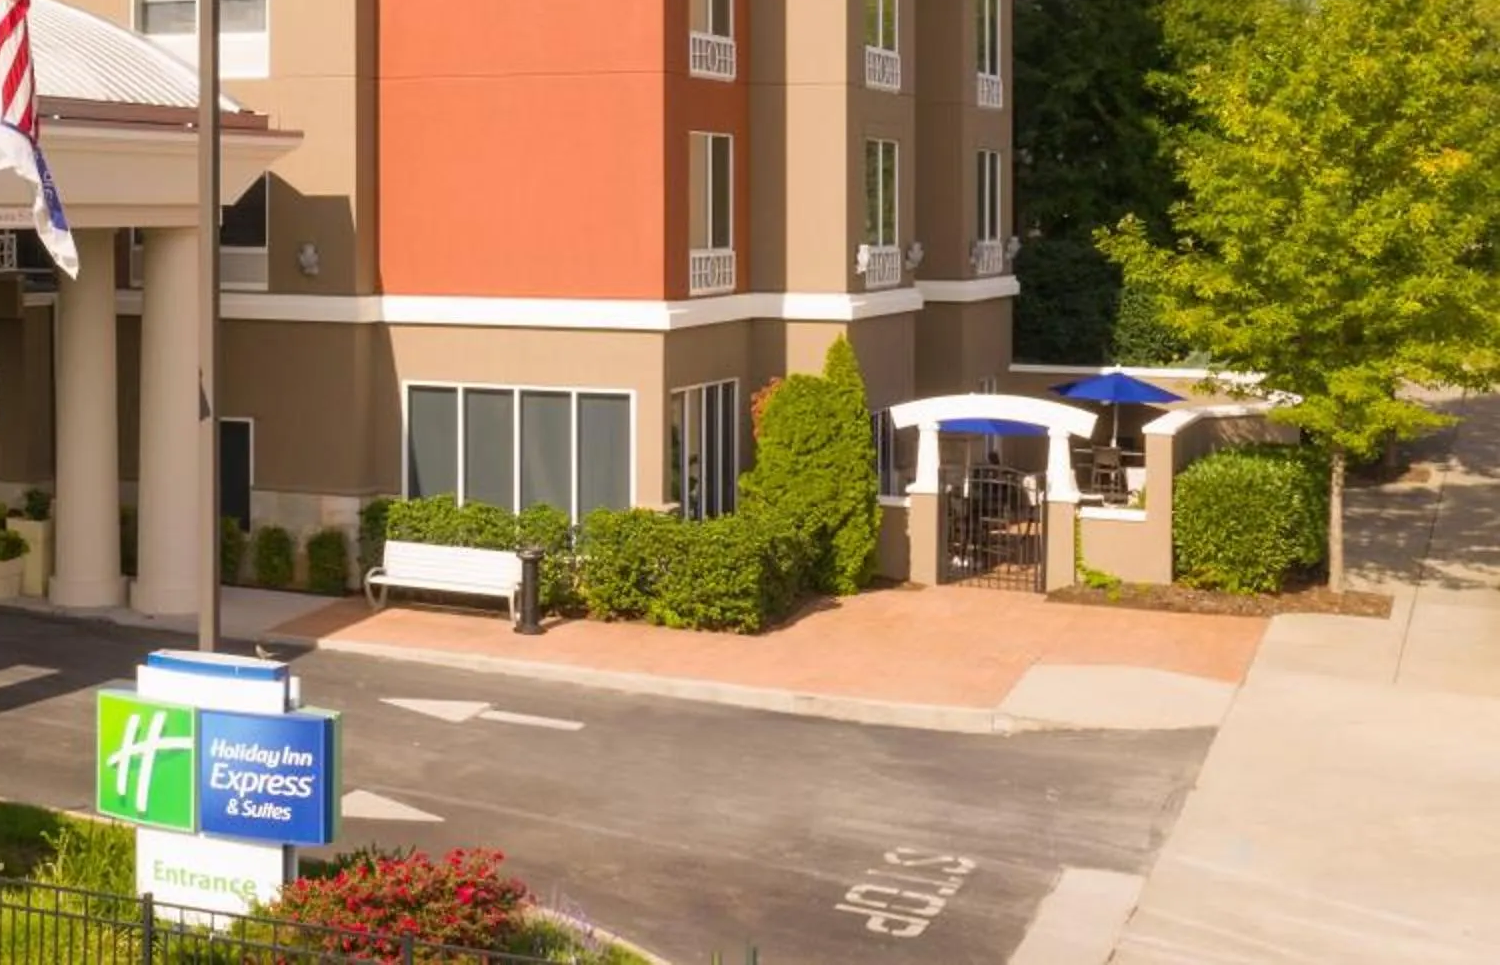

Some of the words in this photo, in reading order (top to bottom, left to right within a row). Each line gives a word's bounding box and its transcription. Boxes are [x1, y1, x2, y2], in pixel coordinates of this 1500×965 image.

[210, 737, 279, 768] Holiday
[283, 746, 313, 766] Inn
[209, 763, 312, 798] Express
[226, 798, 241, 816] &
[244, 799, 292, 821] Suites
[152, 859, 257, 897] Entrance
[834, 847, 977, 937] STOP
